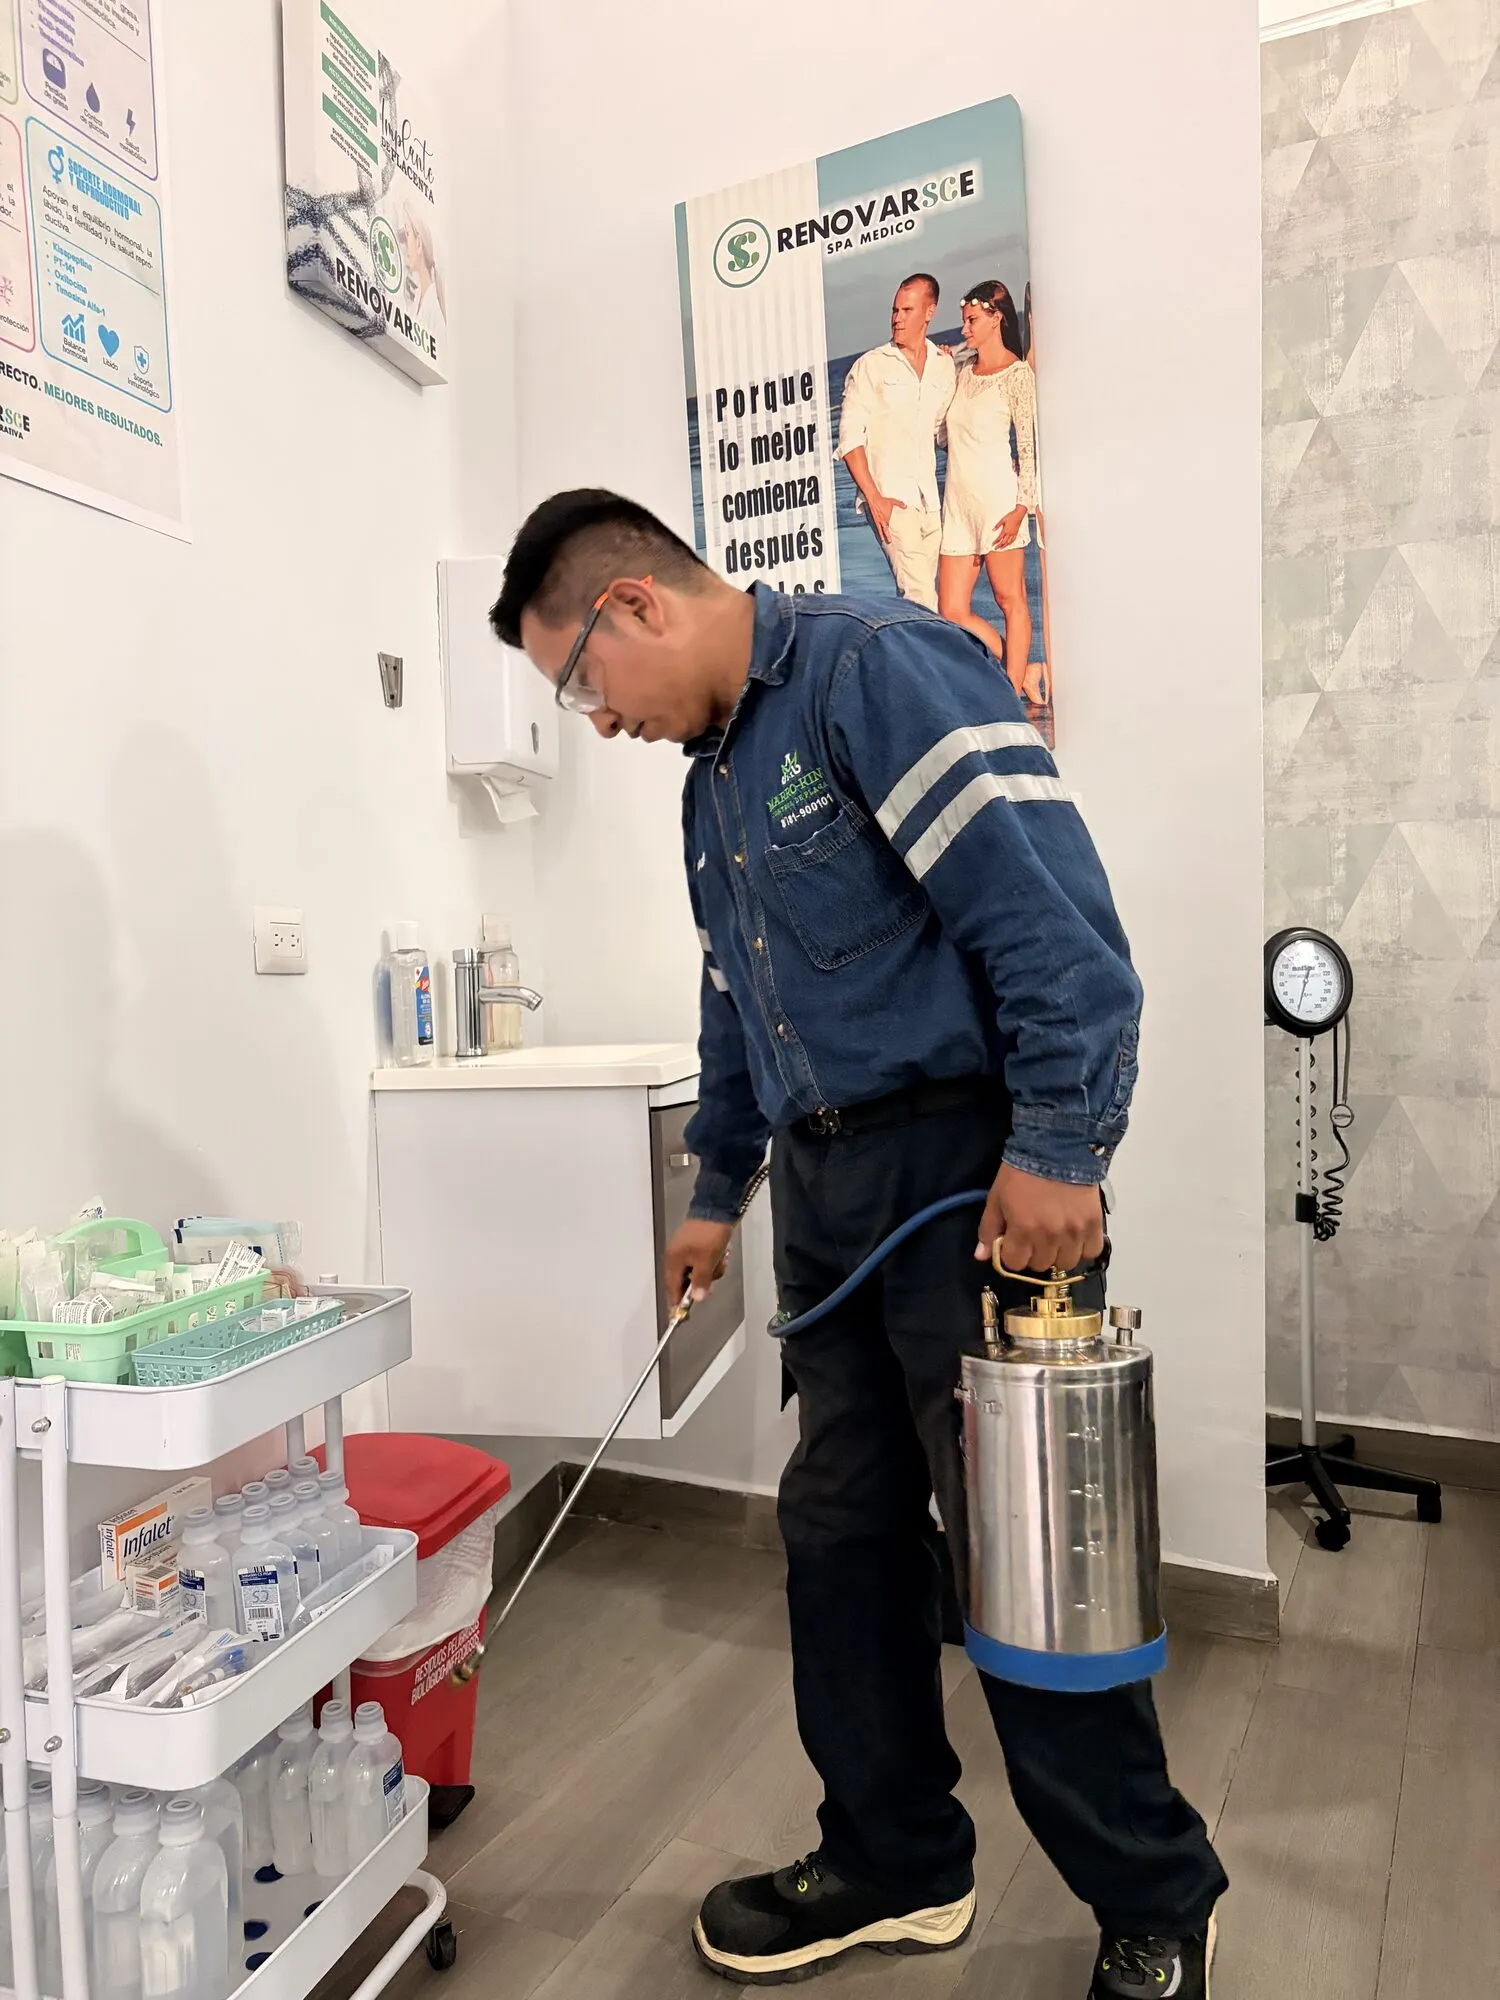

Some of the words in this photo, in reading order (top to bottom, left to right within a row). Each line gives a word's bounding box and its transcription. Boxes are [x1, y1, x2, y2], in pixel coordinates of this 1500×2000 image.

[380, 97, 435, 184] Implante
[391, 152, 435, 204] PLACENTA
[42, 185, 69, 206] Apoyan
[72, 204, 78, 213] el
[82, 210, 111, 232] equilibrio
[114, 228, 144, 254] hormonal,
[147, 248, 153, 258] la
[44, 214, 71, 234] ductiva.
[66, 211, 72, 222] la
[74, 217, 102, 240] fertilidad
[109, 238, 116, 248] la
[117, 244, 134, 259] salud
[776, 169, 975, 253] RENOVARSCE
[826, 239, 853, 255] SPA
[859, 219, 915, 245] MEDICO
[336, 257, 437, 360] RENOVARSCE
[44, 381, 94, 415] MEJORES
[97, 405, 163, 447] RESULTADOS.
[715, 371, 814, 423] Porque
[718, 438, 739, 473] lo
[751, 422, 816, 468] mejor
[722, 475, 820, 523] comienza
[725, 523, 823, 575] después
[105, 1528, 115, 1559] Infalet
[123, 1516, 172, 1558] Infalet
